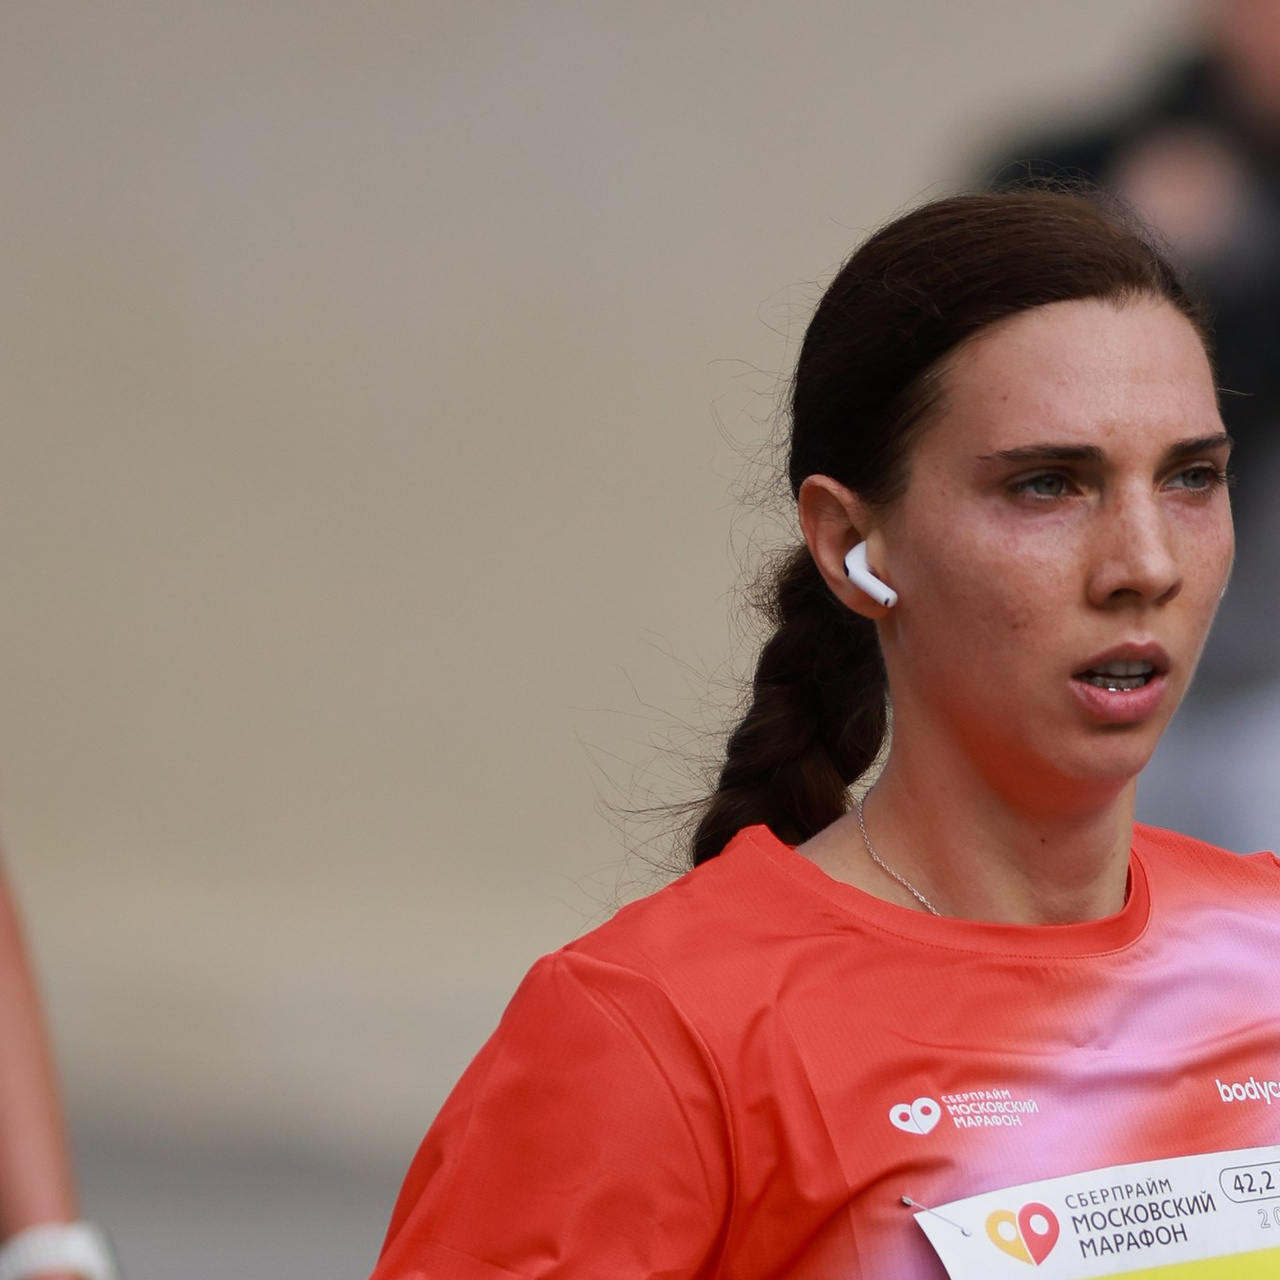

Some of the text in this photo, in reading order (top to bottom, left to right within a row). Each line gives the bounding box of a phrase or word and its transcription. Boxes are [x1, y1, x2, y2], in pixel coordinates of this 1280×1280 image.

[941, 1088, 1011, 1104] СБЕРПРАЙМ
[946, 1099, 1039, 1115] МОСКОВСКИЙ
[953, 1114, 1022, 1129] МАРАФОН
[1065, 1177, 1173, 1210] СБЕРПРАЙМ
[1232, 1169, 1274, 1196] 42,2
[1071, 1190, 1217, 1234] МОСКОВСКИЙ
[1079, 1223, 1188, 1259] МАРАФОН
